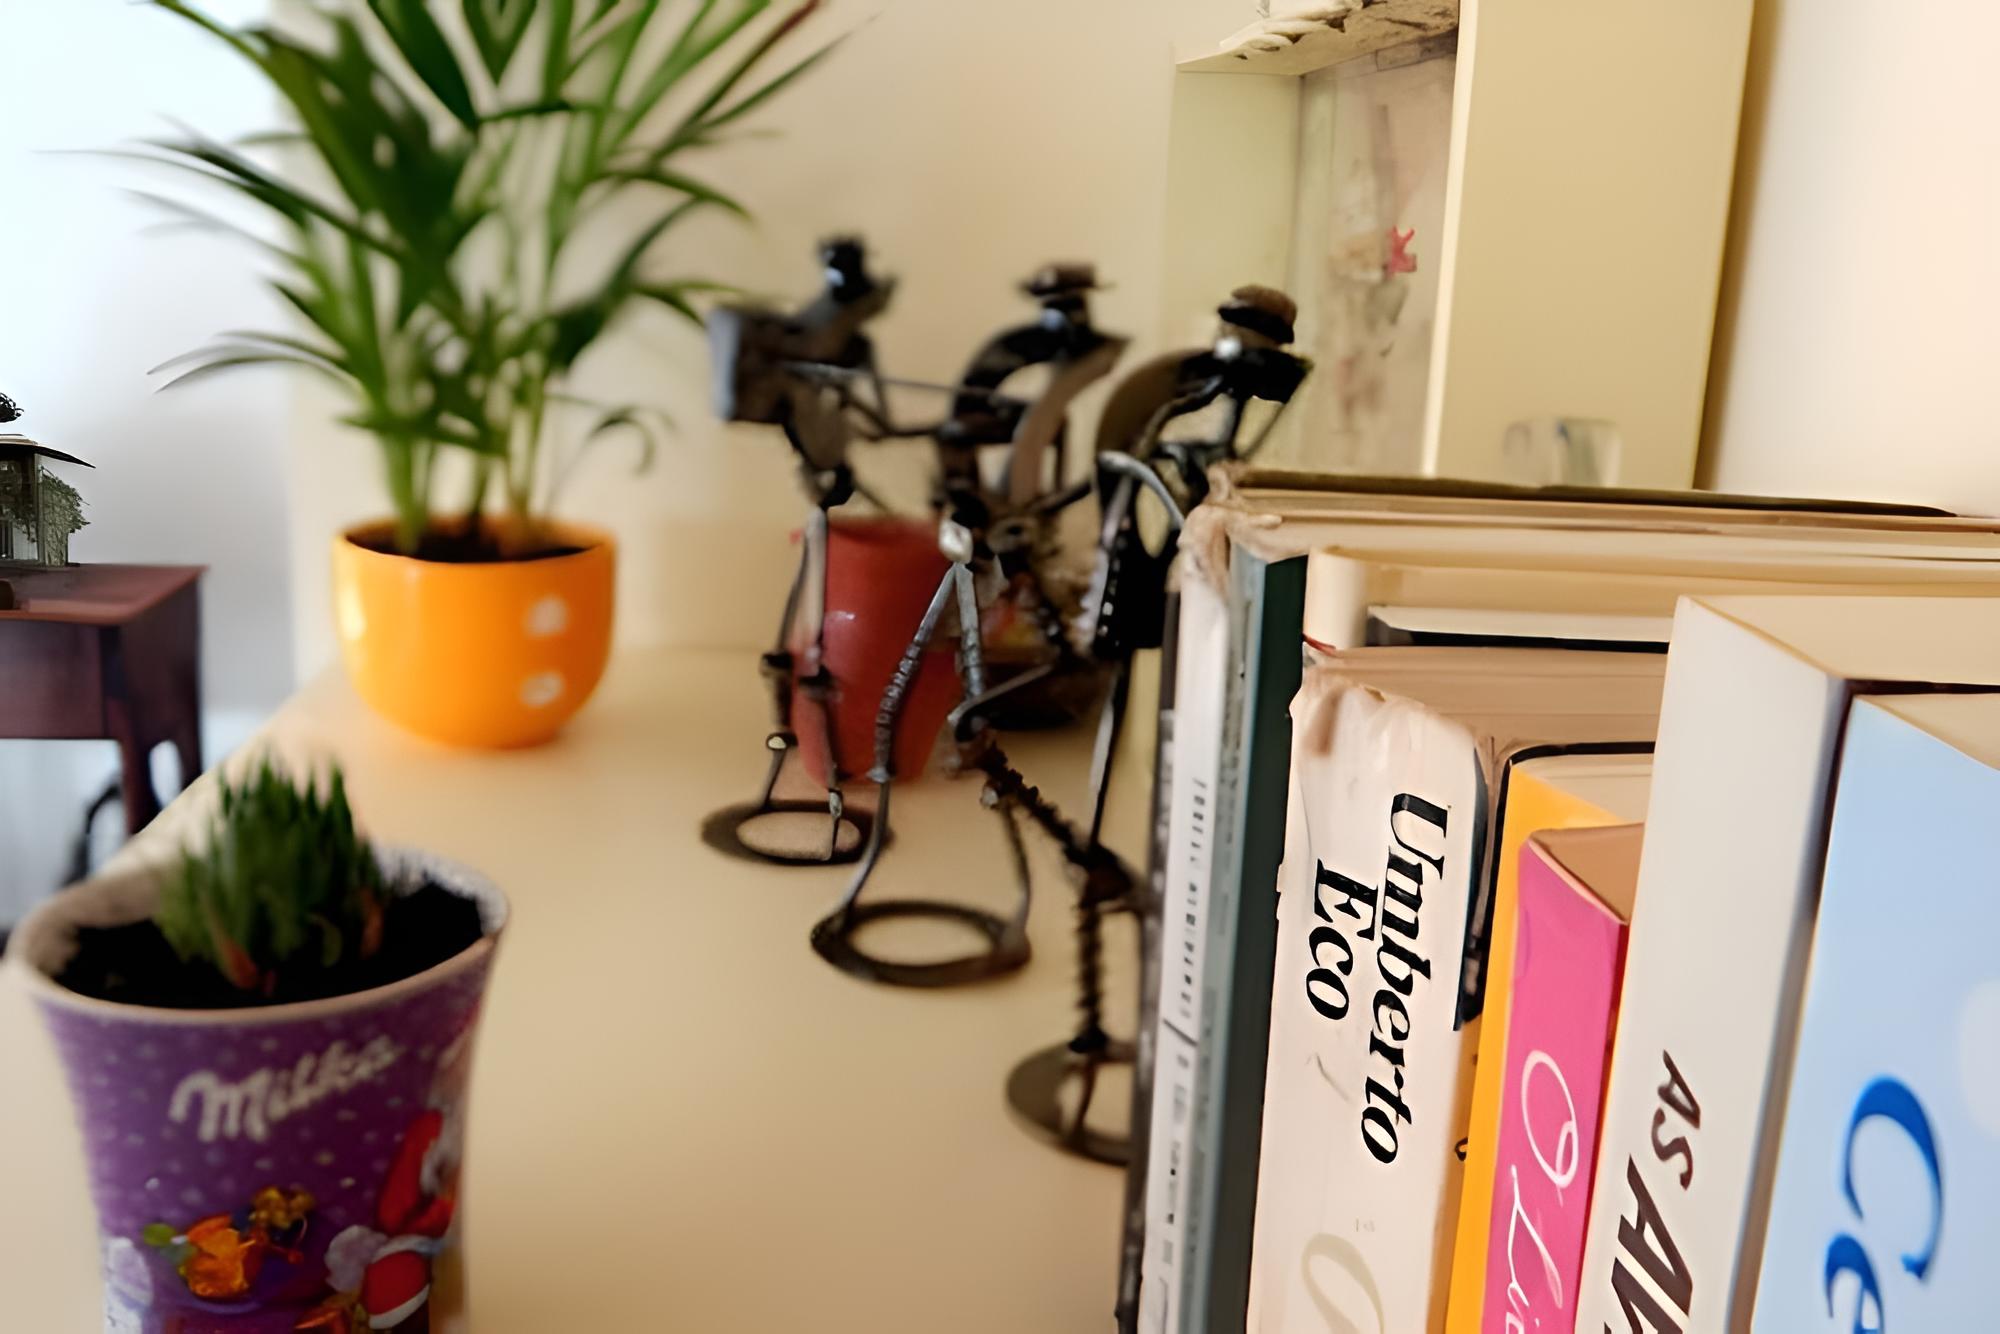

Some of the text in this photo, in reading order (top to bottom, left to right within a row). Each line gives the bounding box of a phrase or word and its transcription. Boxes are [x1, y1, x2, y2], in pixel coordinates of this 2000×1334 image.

[1305, 858, 1379, 1020] Eco
[1360, 793, 1449, 1164] Umberto
[168, 1036, 401, 1142] Milka
[1521, 1050, 1579, 1206] O
[1604, 1049, 1701, 1334] AS AV
